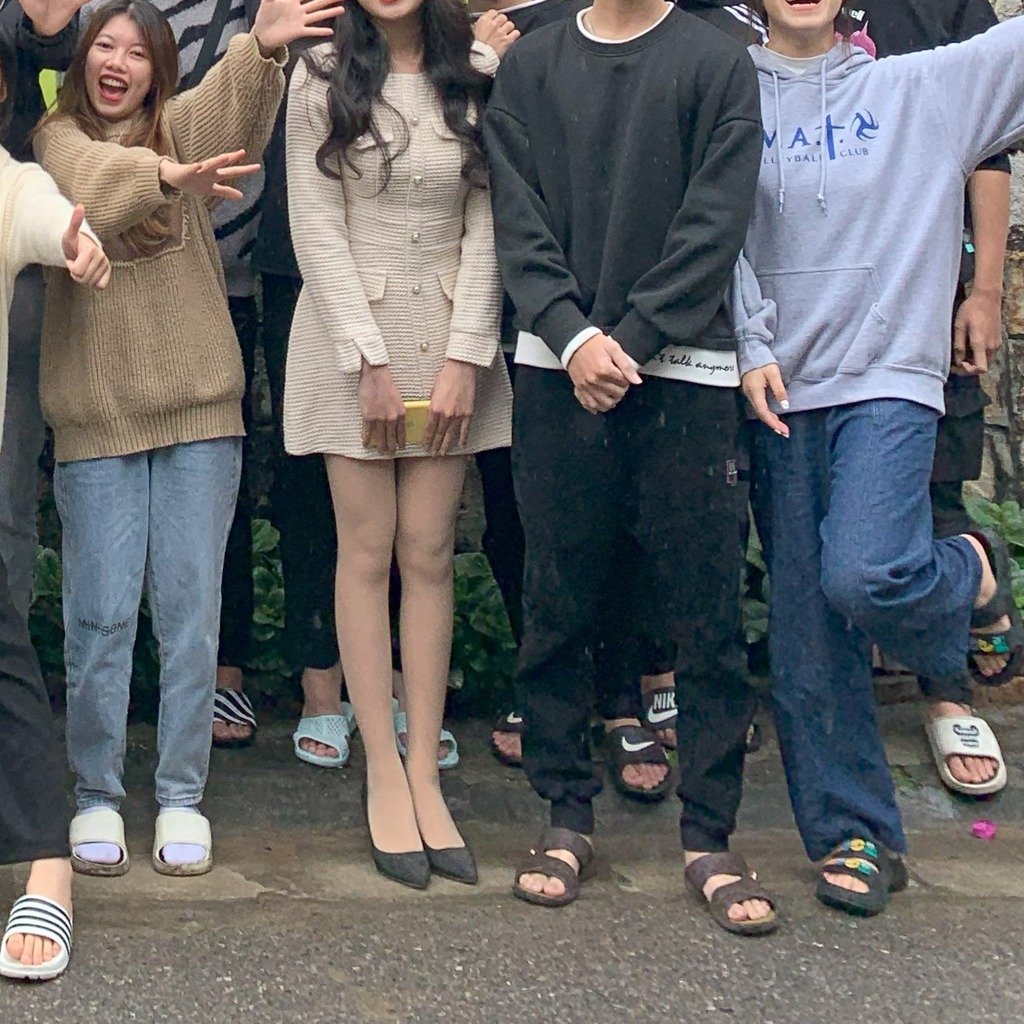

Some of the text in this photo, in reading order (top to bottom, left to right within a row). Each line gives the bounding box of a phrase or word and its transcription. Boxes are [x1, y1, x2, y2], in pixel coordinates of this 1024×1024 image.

[839, 147, 870, 158] CLUB
[669, 355, 693, 367] talk
[653, 691, 677, 710] NIK
